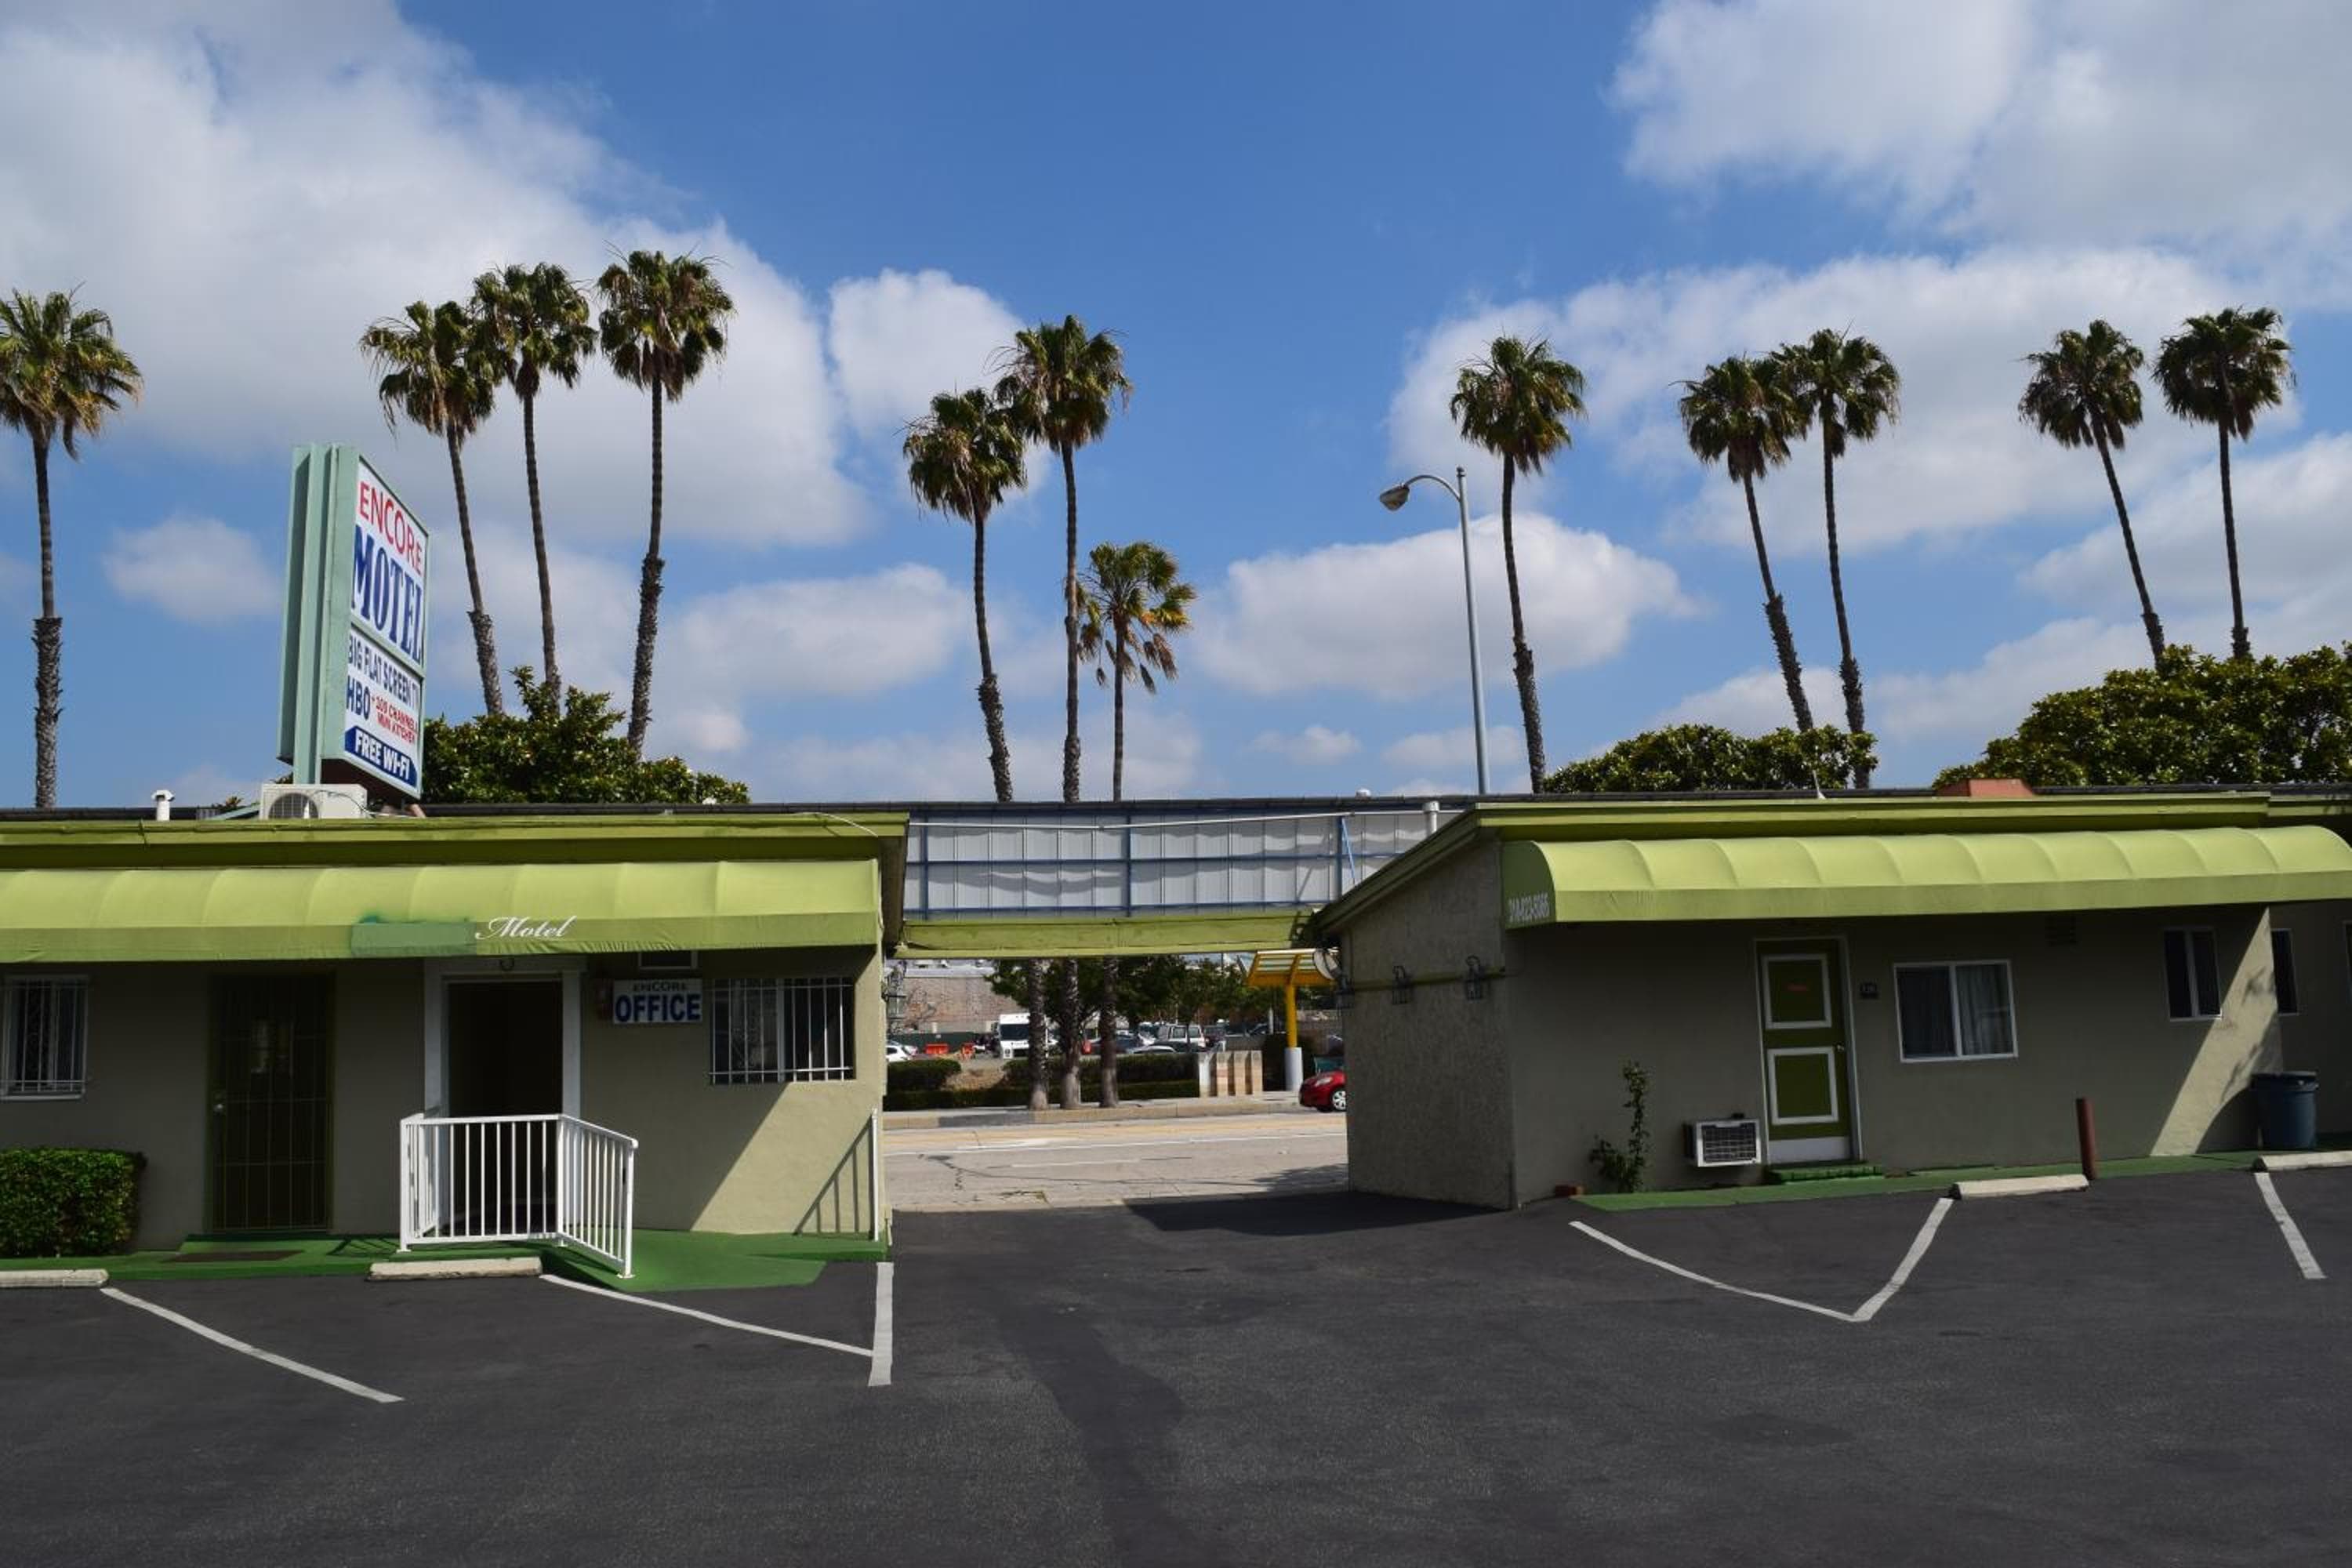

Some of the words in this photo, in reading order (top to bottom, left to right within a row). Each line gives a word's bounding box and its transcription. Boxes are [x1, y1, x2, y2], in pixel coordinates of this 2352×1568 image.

[359, 481, 423, 576] ENCORE
[352, 524, 422, 665] MOTEL
[348, 634, 362, 670] BIG
[364, 645, 382, 687] FLAT
[383, 661, 412, 707] SCREEN
[346, 674, 370, 720] HBO
[354, 728, 382, 766] FREE
[383, 745, 411, 780] WI-FI
[475, 915, 577, 940] Motel
[615, 993, 702, 1022] OFFICE
